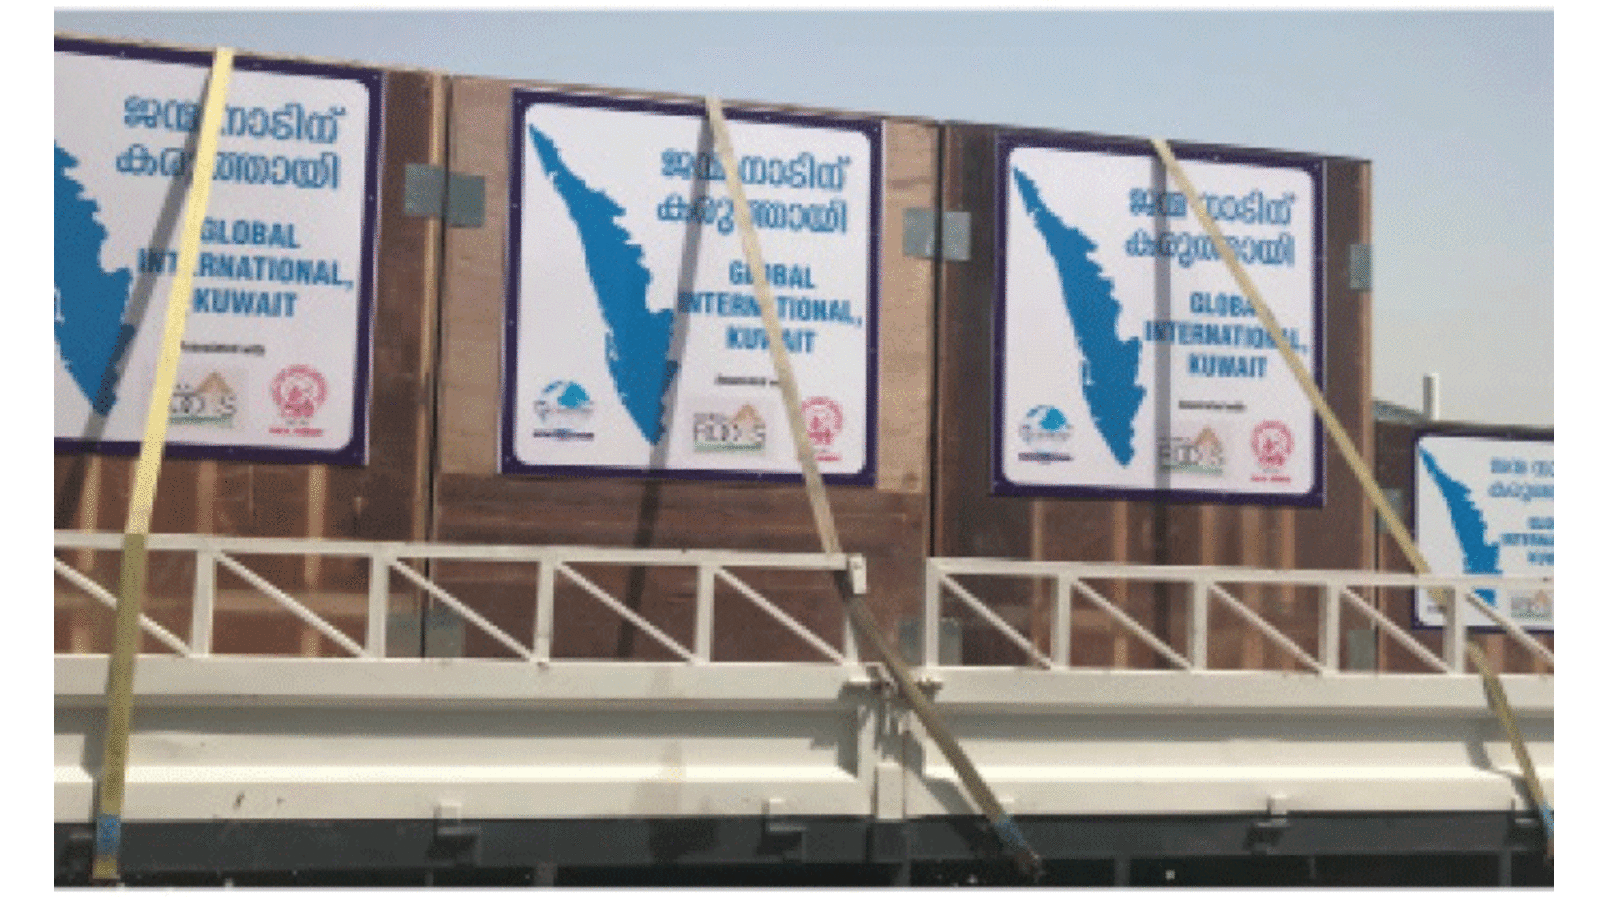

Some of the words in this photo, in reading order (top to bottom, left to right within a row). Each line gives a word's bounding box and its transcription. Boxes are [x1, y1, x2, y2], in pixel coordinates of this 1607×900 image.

[137, 248, 354, 291] INTRNATIONAL,
[728, 259, 816, 290] GLBAL
[192, 287, 298, 318] KUWAIT
[677, 291, 863, 328] INTERNTIONAL,
[1189, 291, 1259, 318] GLOBA
[1188, 352, 1268, 379] KUWAIT
